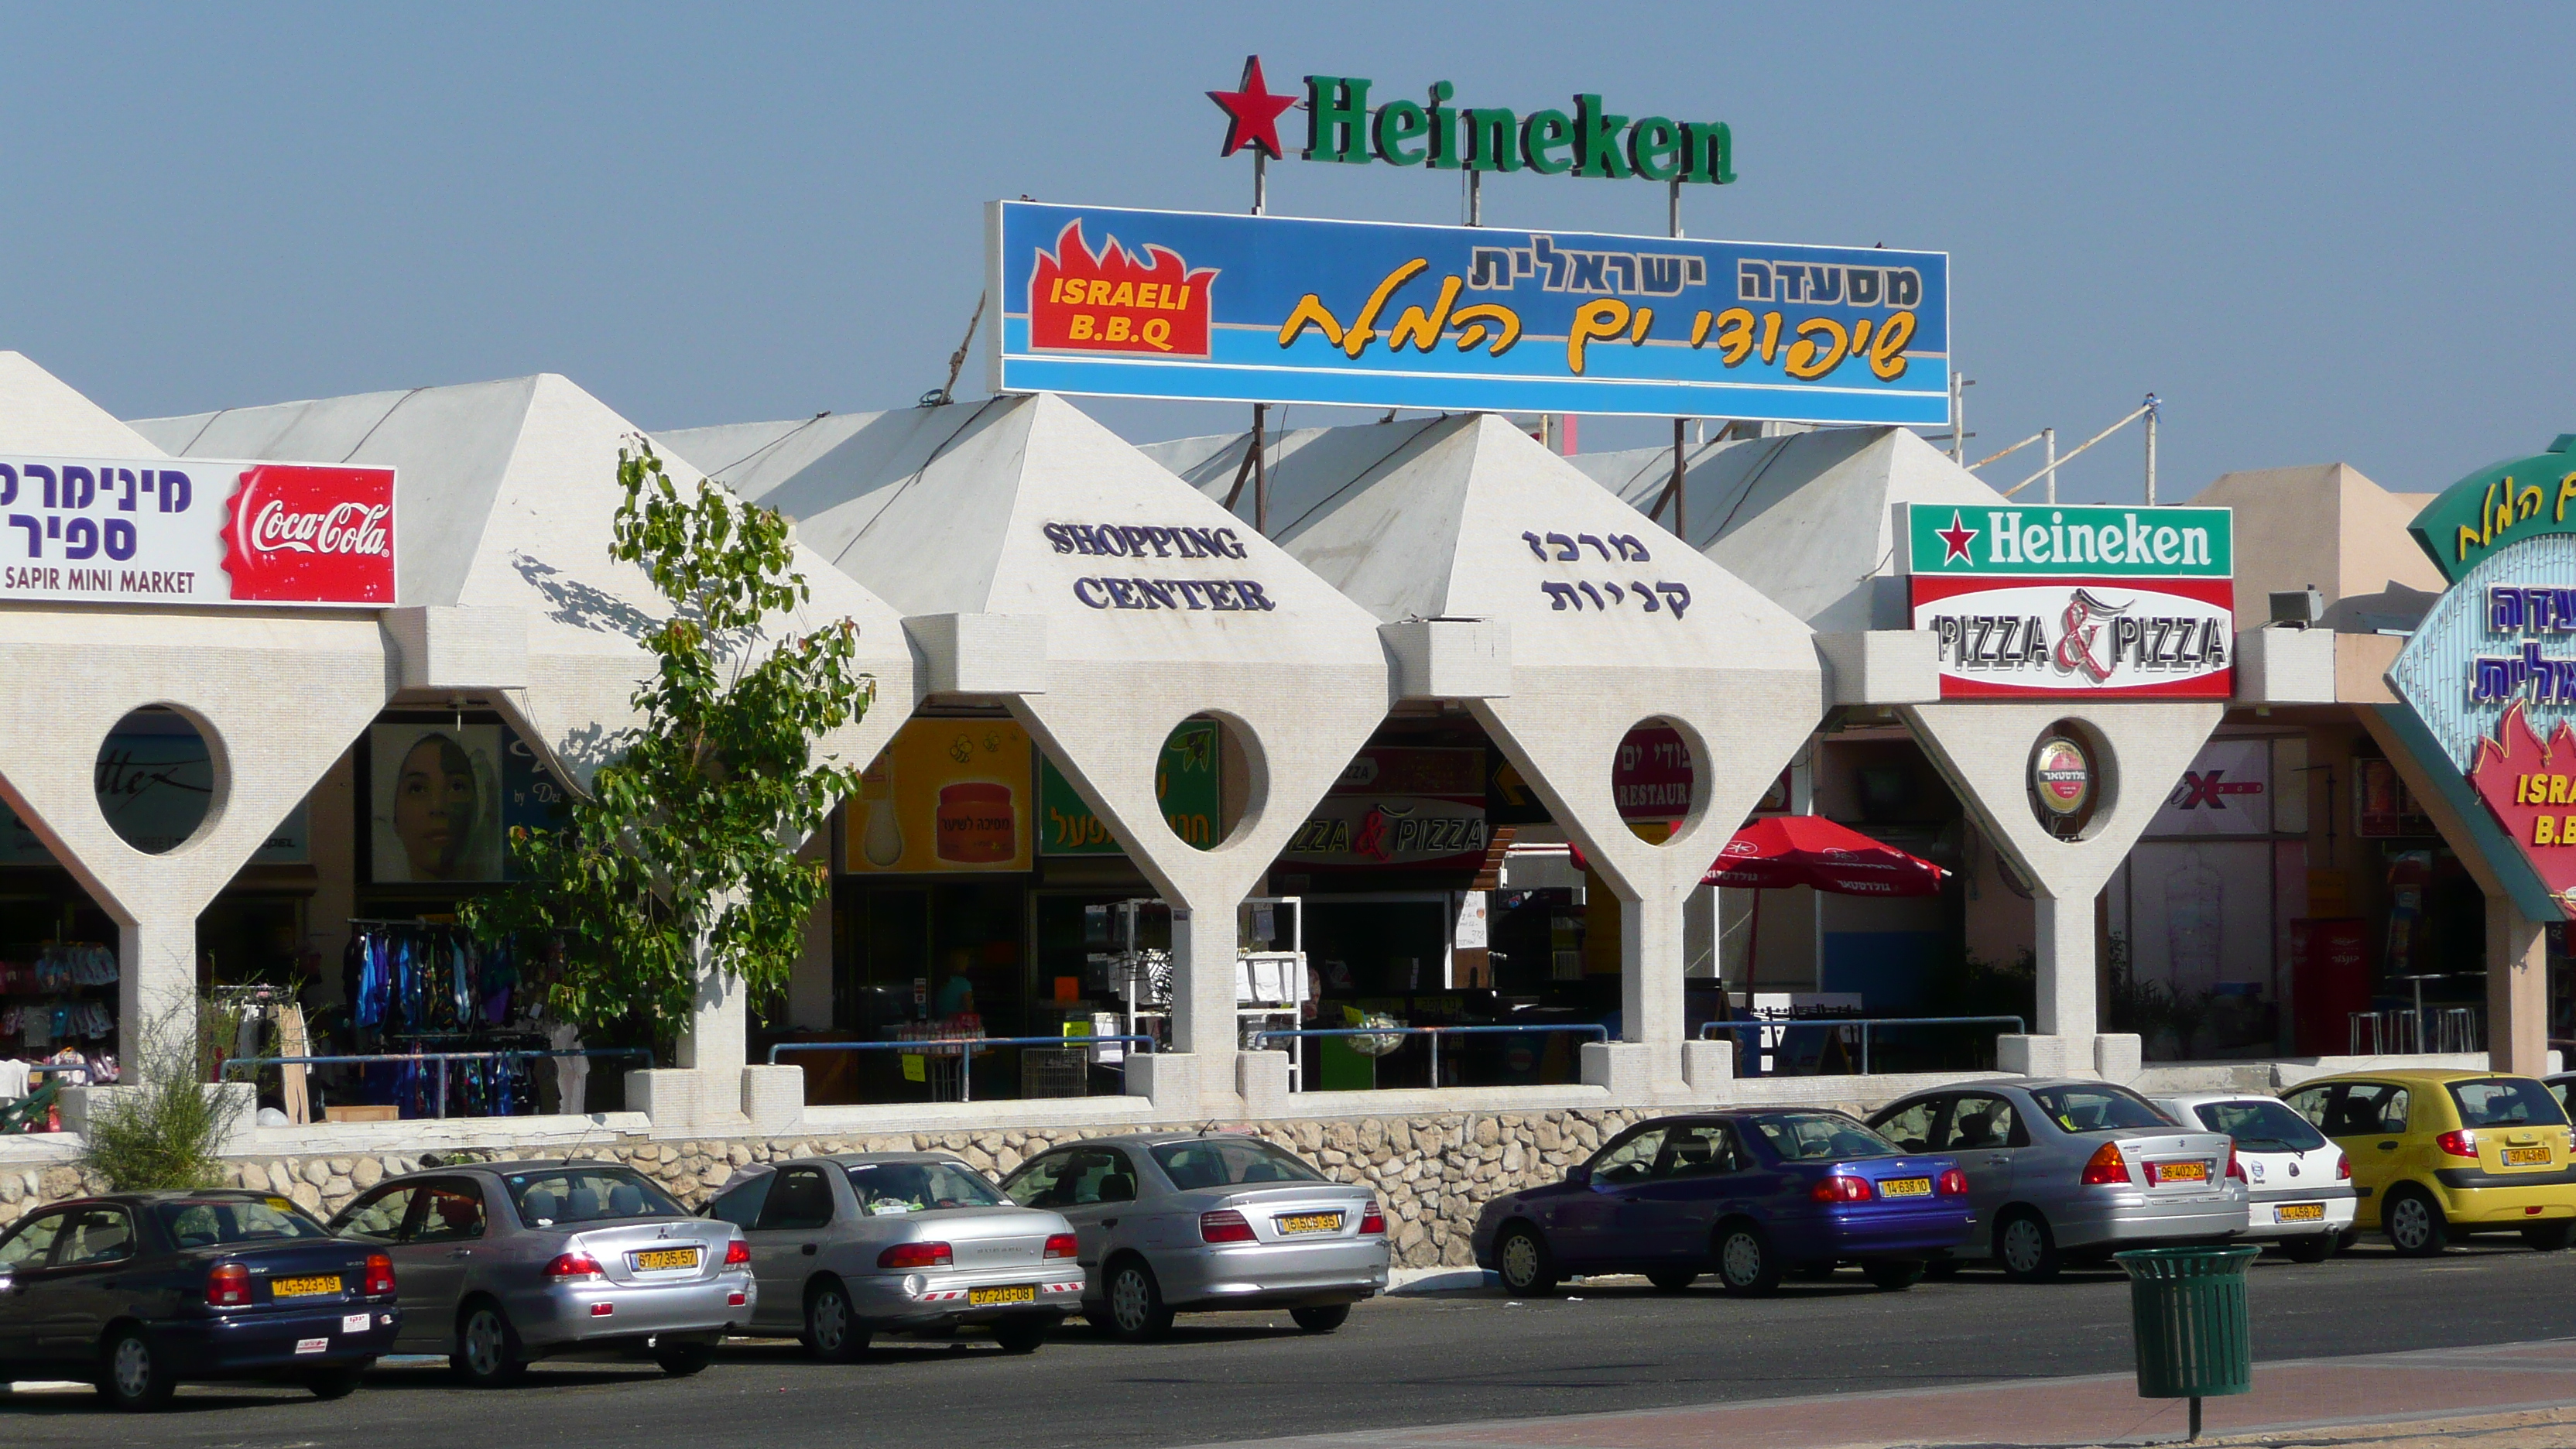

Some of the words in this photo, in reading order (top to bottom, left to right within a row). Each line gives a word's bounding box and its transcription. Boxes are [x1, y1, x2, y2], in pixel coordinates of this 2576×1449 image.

[1303, 75, 1738, 184] Heineken
[1468, 235, 1706, 296] ישראלית
[1738, 258, 1922, 310] מסעדה
[1050, 278, 1190, 311] ISRAELI
[1278, 258, 1522, 360] המלח
[1068, 314, 1173, 351] B.B.Q
[1567, 298, 1654, 376] ים
[1690, 307, 1917, 382] שיפודי
[9, 513, 137, 561] ספיר
[252, 500, 390, 556] Coca-Cola
[2458, 476, 2543, 561] המלח
[1043, 522, 1249, 560] SHOPPING
[1522, 530, 1651, 563] מרכז
[1989, 512, 2211, 566] Heineken
[5, 567, 60, 591] SAPIR
[68, 569, 112, 592] MINI
[120, 570, 195, 594] MARKET
[1074, 577, 1276, 611] CENTER
[1541, 581, 1692, 621] קניות
[2489, 584, 2576, 633] עדה
[1934, 614, 2054, 665] PIZZA
[2057, 598, 2115, 680] &
[2114, 615, 2230, 664] PIZZA
[2473, 639, 2576, 704] אלית
[1341, 765, 1370, 779] IZZA
[1622, 743, 1643, 771] ים
[1653, 742, 1693, 769] פודי
[96, 748, 212, 813] ttex
[514, 789, 526, 807] by
[1619, 783, 1693, 807] RESTAUR
[2516, 773, 2576, 803] ISR
[1050, 806, 1115, 848] פעל
[1288, 818, 1351, 852] ZZA
[1396, 818, 1486, 852] PIZZA
[2534, 815, 2576, 844] B.B
[276, 1276, 336, 1293] 74-523-19
[975, 1287, 1030, 1303] 37-213-08
